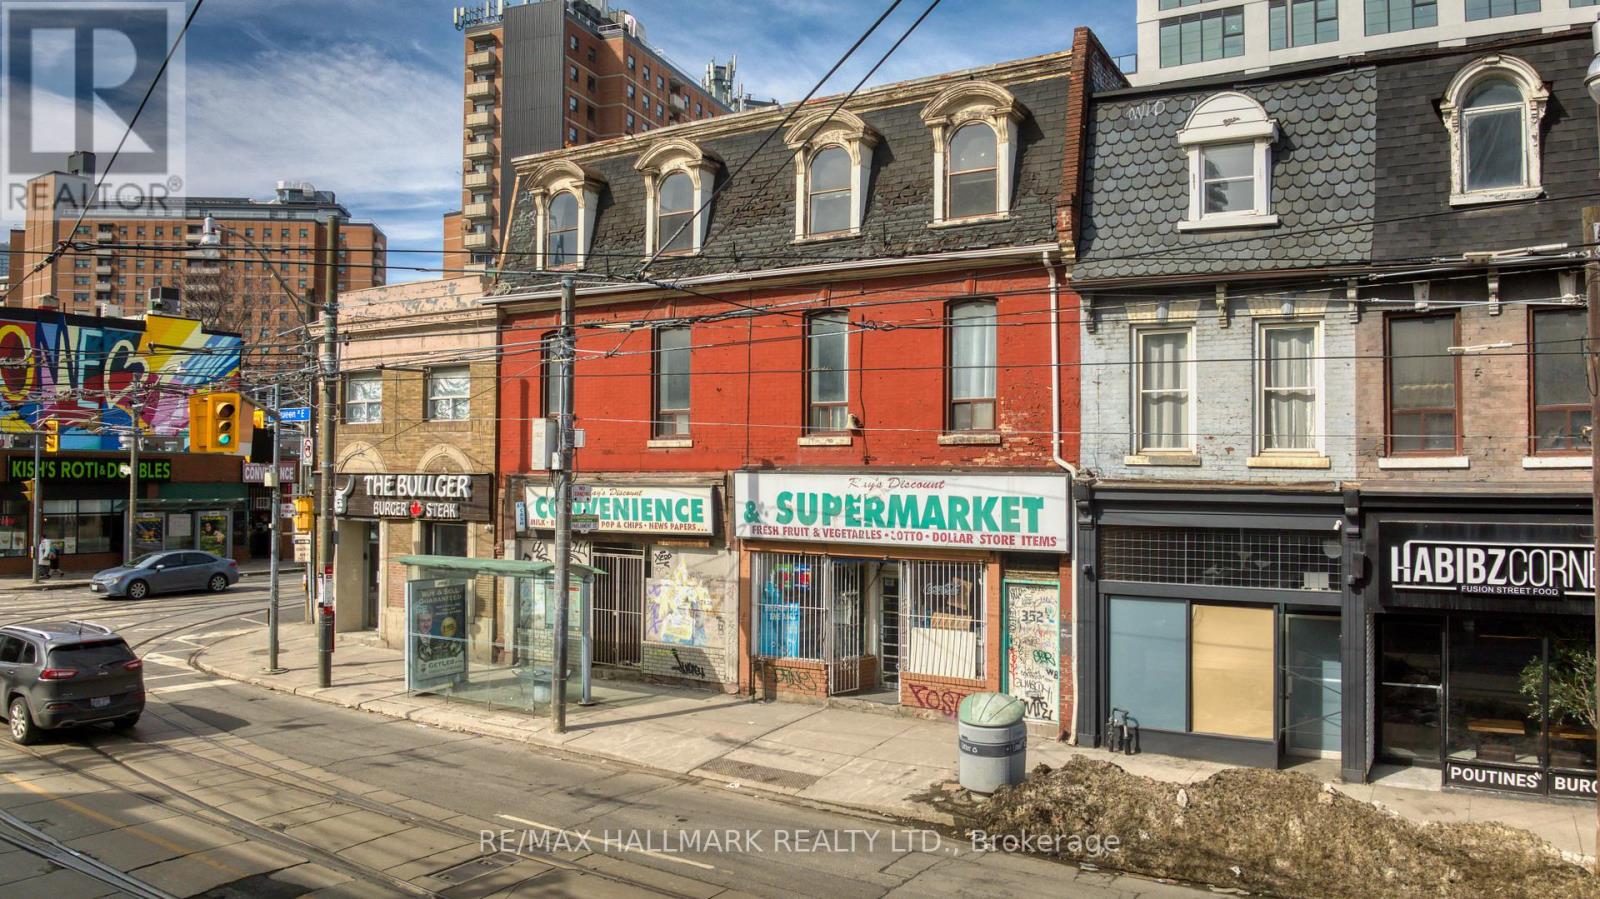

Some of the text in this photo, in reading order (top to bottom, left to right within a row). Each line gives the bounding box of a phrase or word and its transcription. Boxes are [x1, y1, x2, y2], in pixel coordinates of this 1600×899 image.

[12, 461, 56, 478] KISH'S
[107, 463, 170, 478] DOBLES
[244, 467, 294, 479] CONVNCE
[364, 475, 472, 497] THE BULLGER
[887, 477, 945, 490] Discount
[608, 487, 644, 497] Discount
[373, 501, 457, 517] BURGER STEAK
[743, 490, 1044, 533] & SUPERMARKET
[623, 521, 643, 529] CHIPS
[648, 522, 668, 530] NEWS
[751, 525, 779, 536] FRESH
[783, 526, 810, 537] FRUIT
[813, 527, 820, 537] &
[822, 527, 882, 540] VEGETABLES
[932, 532, 974, 544] DOLLAR
[979, 534, 1015, 546] STORE
[1021, 535, 1057, 547] ITEMS
[1461, 585, 1559, 596] FUSION STREET FOOD
[1021, 610, 1043, 623] 352
[1451, 766, 1538, 788] POUTINES
